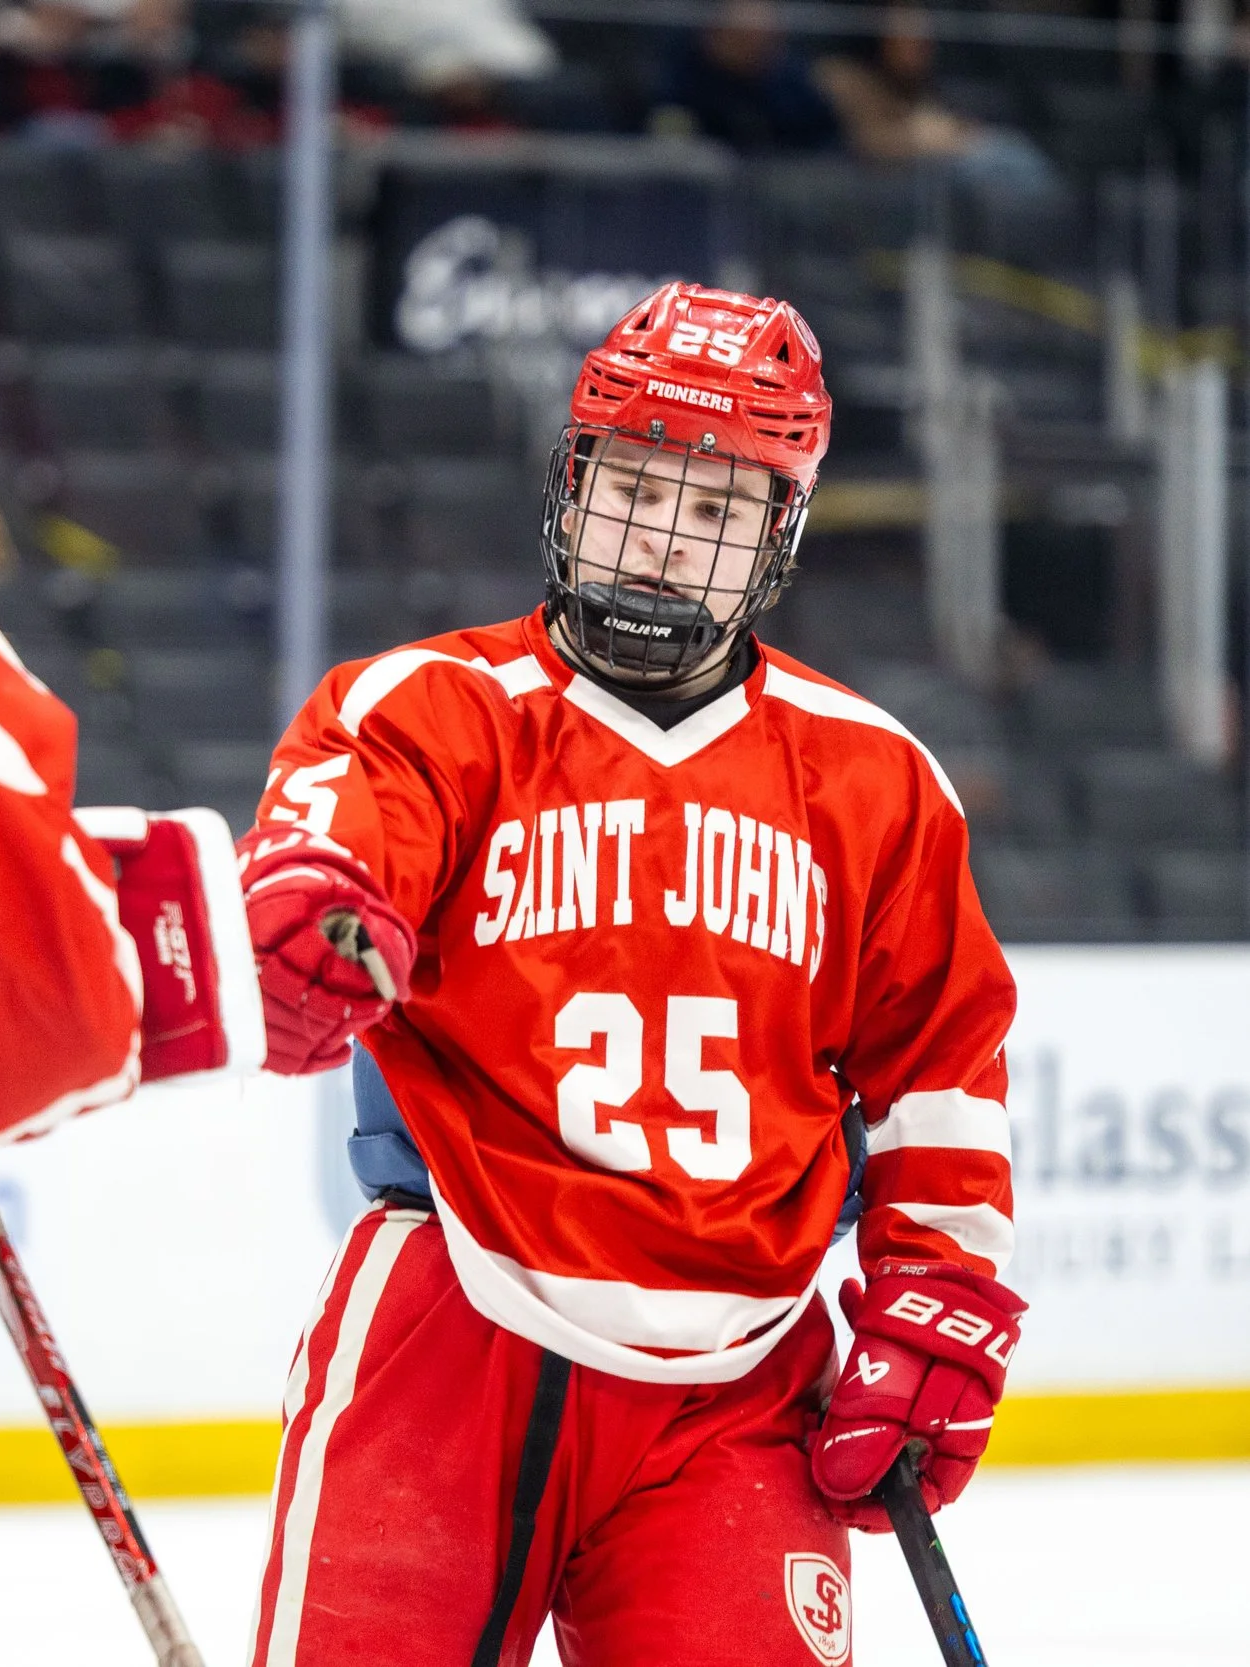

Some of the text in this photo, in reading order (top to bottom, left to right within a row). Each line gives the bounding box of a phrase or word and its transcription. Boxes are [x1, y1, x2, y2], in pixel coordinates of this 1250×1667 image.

[666, 320, 750, 367] 25
[645, 379, 734, 413] PIONEERS
[256, 753, 352, 837] 5
[473, 798, 646, 948] SAINT
[554, 991, 752, 1181] 25
[1008, 1042, 1250, 1192] lass
[897, 1264, 928, 1276] PRO
